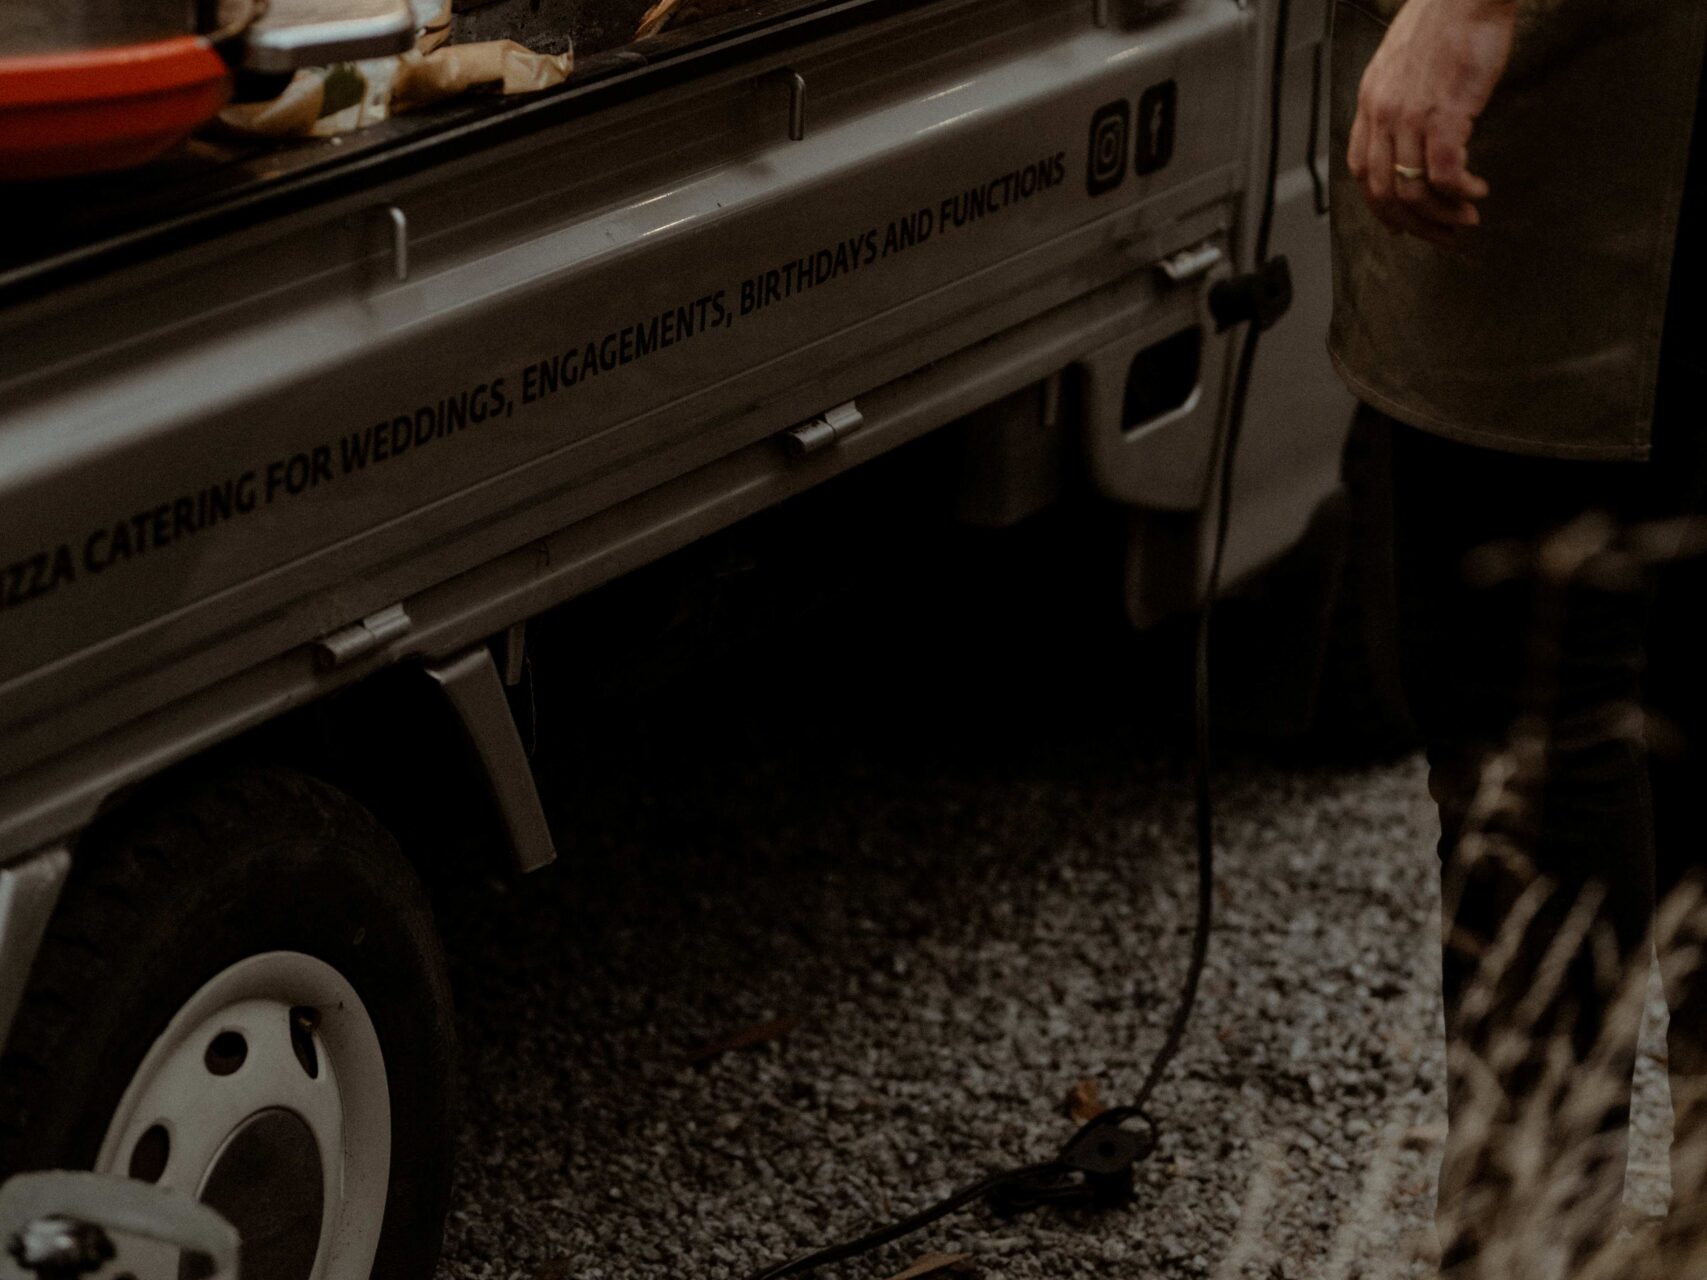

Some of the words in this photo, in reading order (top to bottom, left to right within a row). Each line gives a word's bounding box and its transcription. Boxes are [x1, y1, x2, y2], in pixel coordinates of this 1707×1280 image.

[83, 472, 257, 574] CATERING
[264, 443, 334, 504] FOR
[340, 377, 514, 473] WEDDINGS,
[521, 290, 733, 405] ENGAGEMENTS,
[740, 228, 878, 316] BIRTHDAYS
[882, 207, 934, 257] AND
[939, 151, 1066, 233] FUNCTIONS
